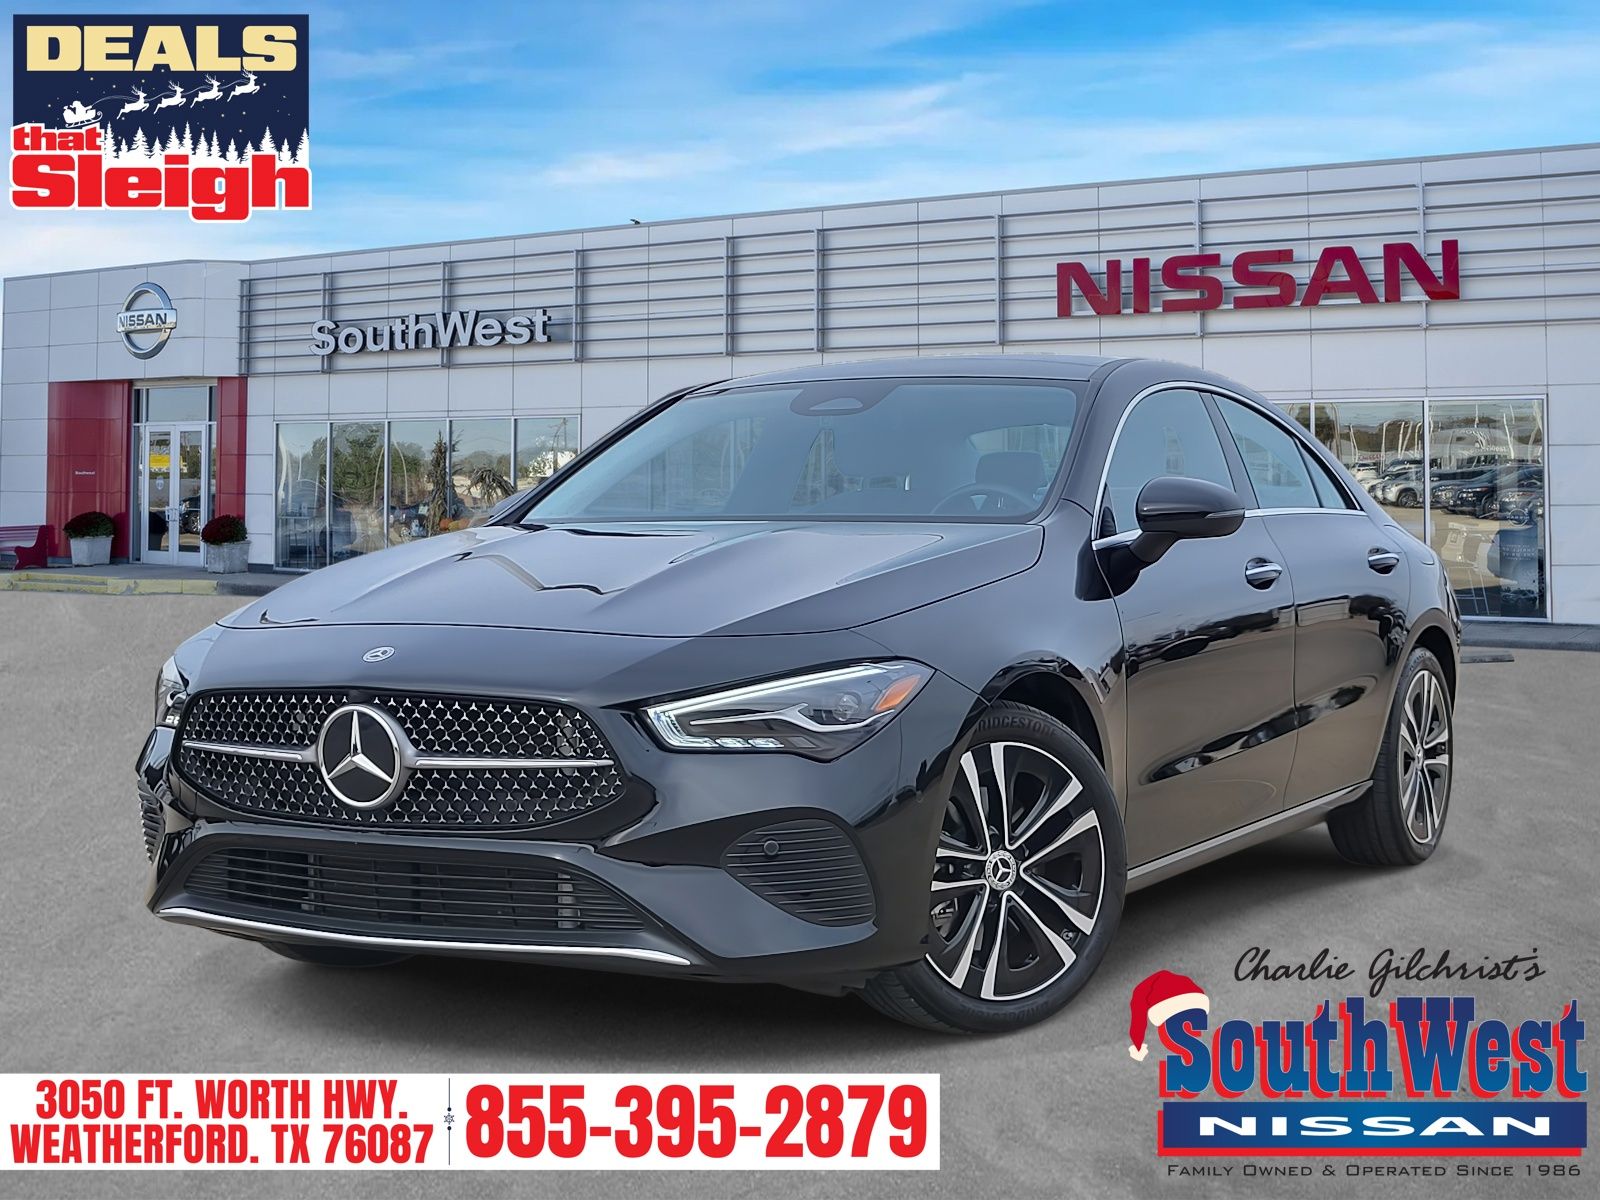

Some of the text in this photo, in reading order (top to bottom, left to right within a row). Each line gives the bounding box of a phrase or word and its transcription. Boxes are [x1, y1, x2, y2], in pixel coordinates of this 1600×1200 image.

[1057, 239, 1461, 318] NISSAN
[119, 312, 167, 328] NISSAN
[308, 308, 552, 356] SouthWest
[979, 715, 1058, 738] RIDGESTONE
